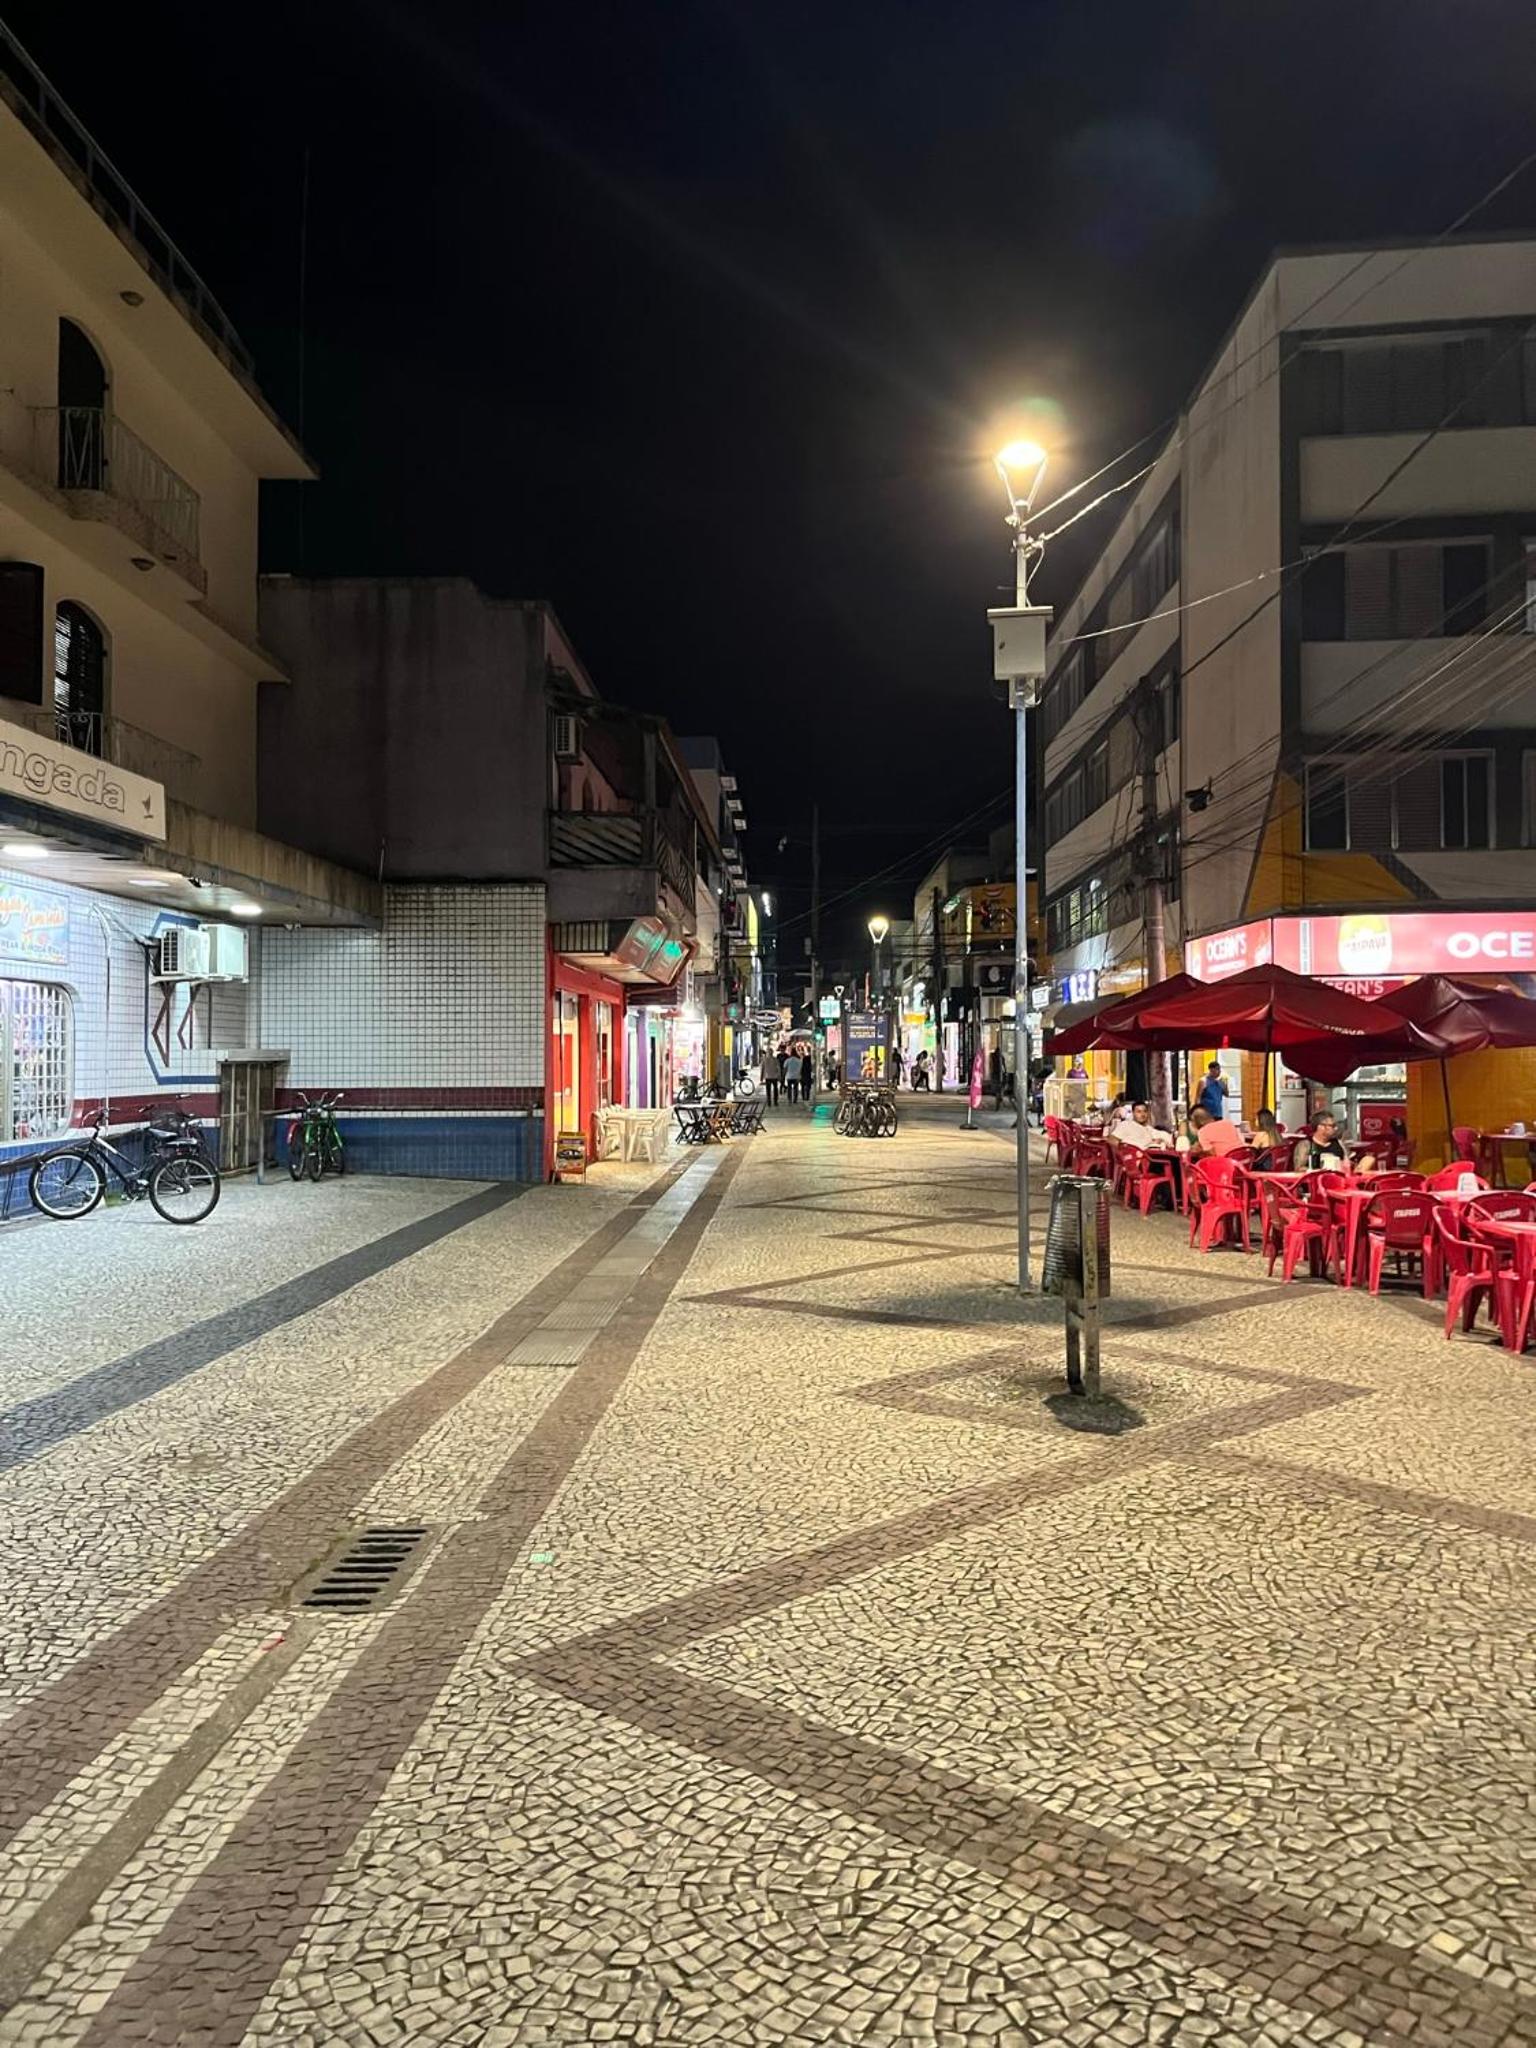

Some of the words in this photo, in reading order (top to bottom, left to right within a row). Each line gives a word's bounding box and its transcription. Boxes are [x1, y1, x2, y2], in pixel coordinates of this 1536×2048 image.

[1206, 932, 1247, 961] OCEAN'S
[1446, 931, 1535, 959] OCE
[1327, 979, 1384, 995] EAN'S
